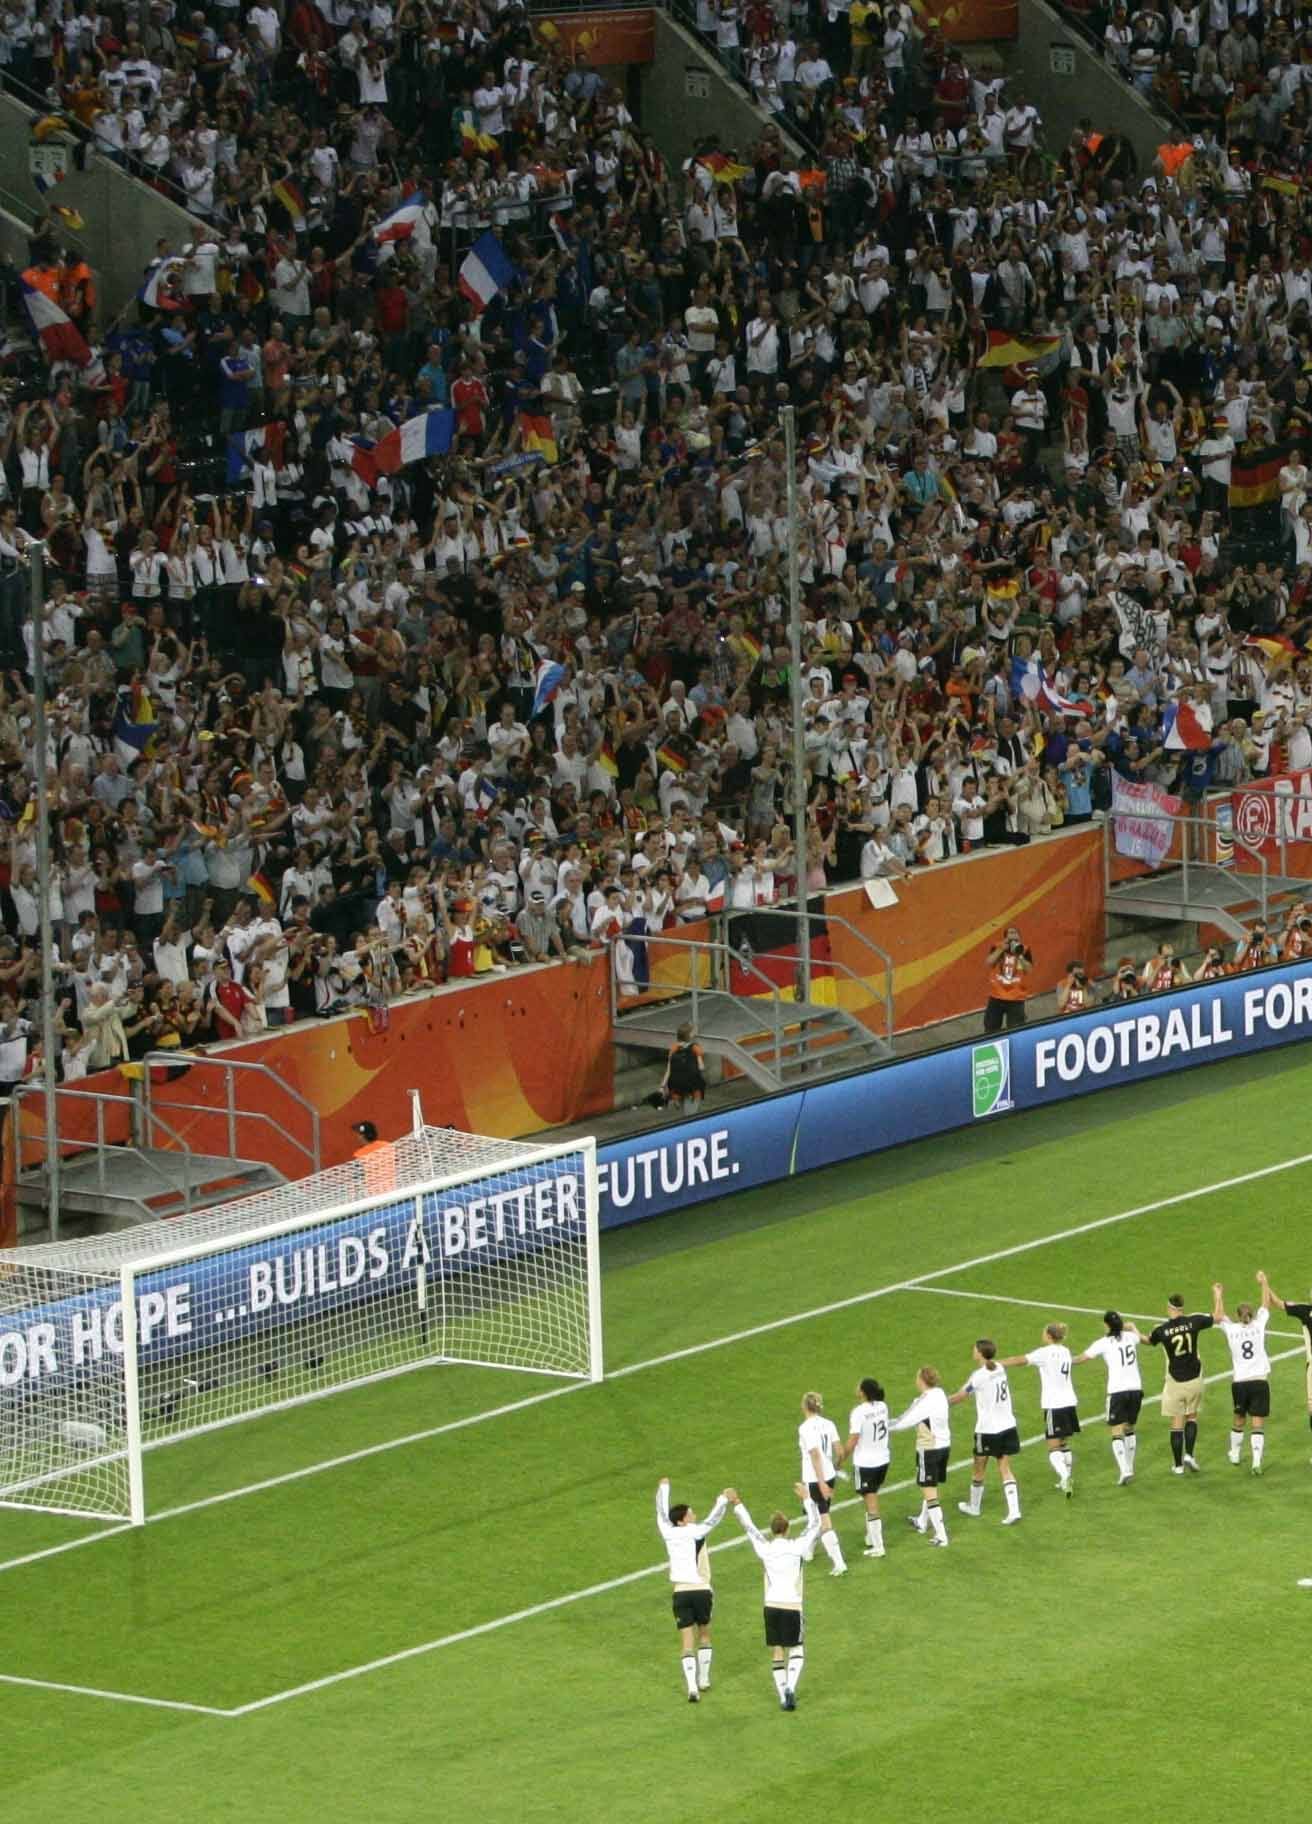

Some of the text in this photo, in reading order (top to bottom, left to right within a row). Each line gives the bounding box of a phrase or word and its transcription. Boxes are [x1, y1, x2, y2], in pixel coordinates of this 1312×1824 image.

[1036, 1002, 1232, 1088] FOOTBALL
[402, 1218, 431, 1269] A
[443, 1174, 579, 1257] BETTER
[1119, 1344, 1136, 1367] 15
[1171, 1332, 1192, 1357] 21
[1241, 1340, 1254, 1360] 8
[1060, 1363, 1069, 1381] 4
[995, 1381, 1008, 1403] 18
[872, 1420, 887, 1443] 13
